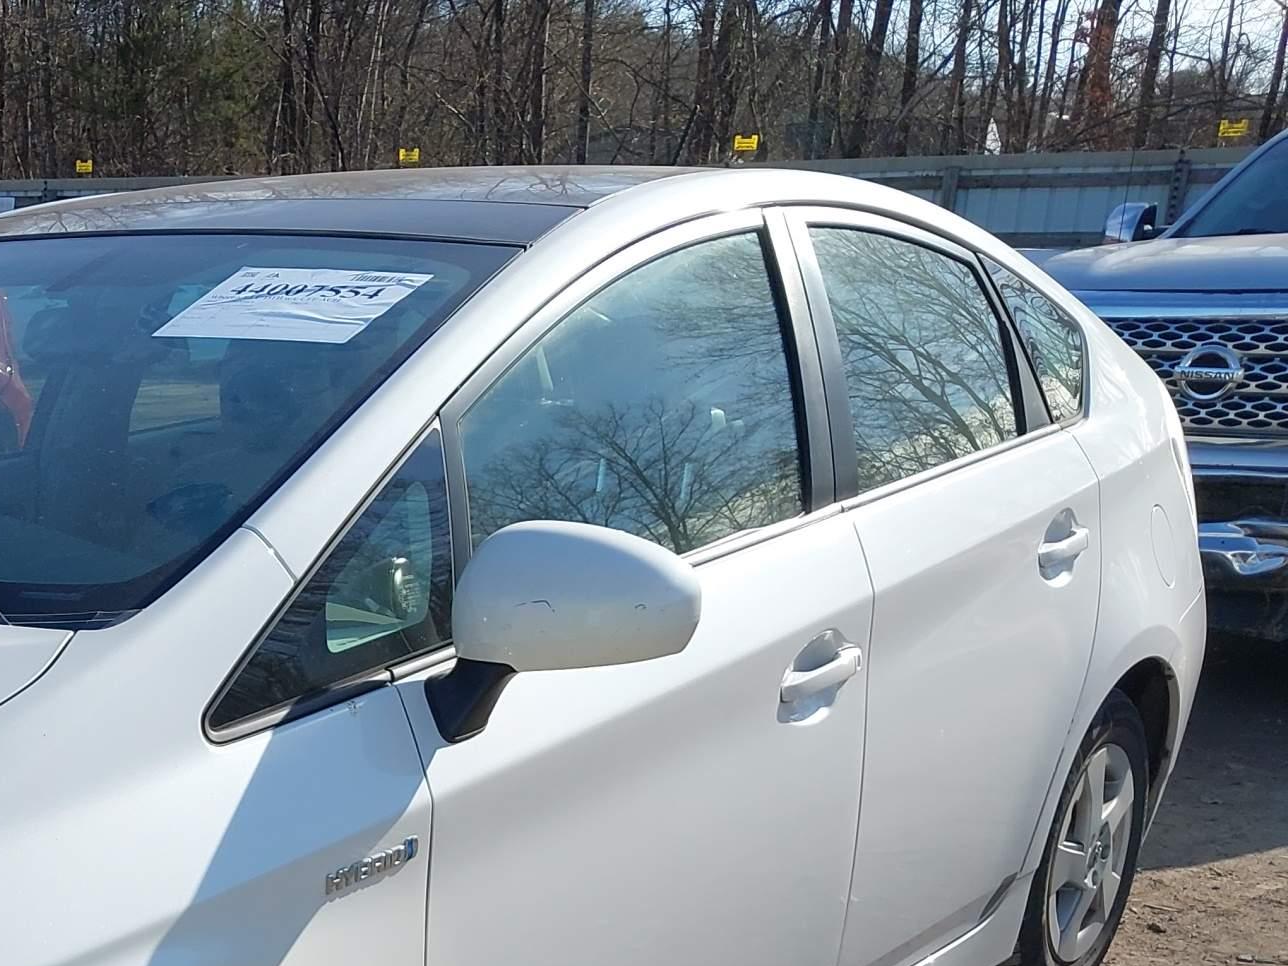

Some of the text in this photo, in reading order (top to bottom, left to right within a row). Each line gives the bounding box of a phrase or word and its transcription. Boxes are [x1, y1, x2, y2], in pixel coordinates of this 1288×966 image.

[230, 282, 386, 300] 44007554
[1180, 370, 1235, 381] NISSAN
[325, 843, 406, 895] HYBRID
